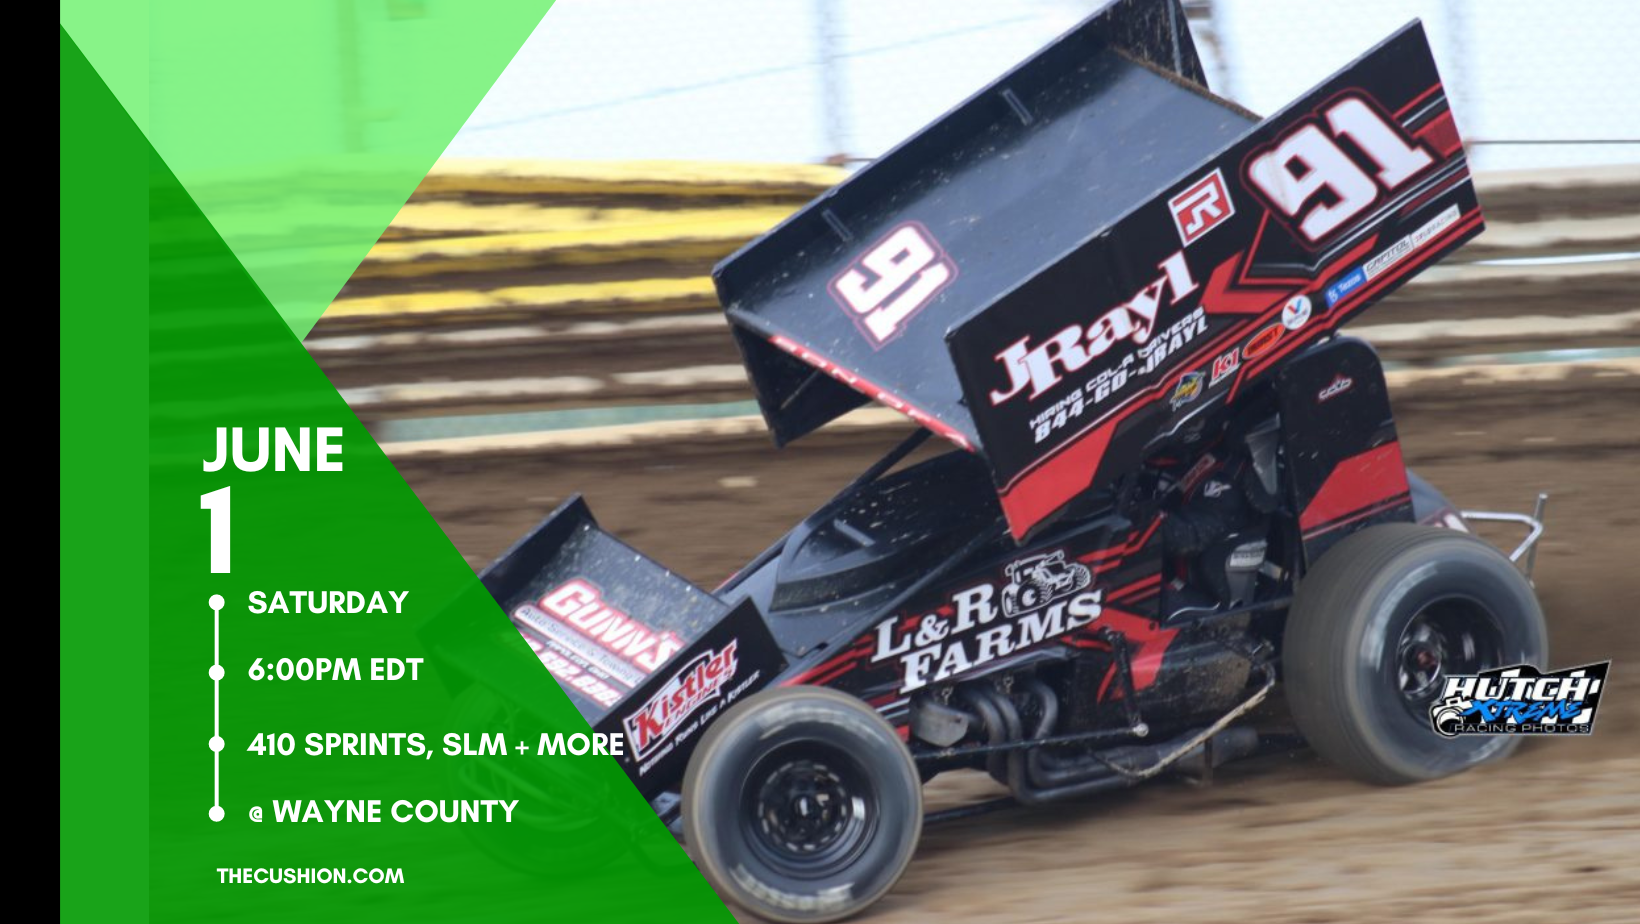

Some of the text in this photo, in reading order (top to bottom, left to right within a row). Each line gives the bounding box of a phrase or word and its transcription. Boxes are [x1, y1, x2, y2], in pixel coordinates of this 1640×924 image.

[1250, 98, 1434, 242] 91
[836, 227, 949, 342] 91
[990, 250, 1199, 405] JRayl
[1033, 314, 1208, 443] 844-GO-JRAYL
[871, 584, 997, 662] L&R
[900, 590, 1101, 694] FARMS
[633, 643, 735, 751] Kistler
